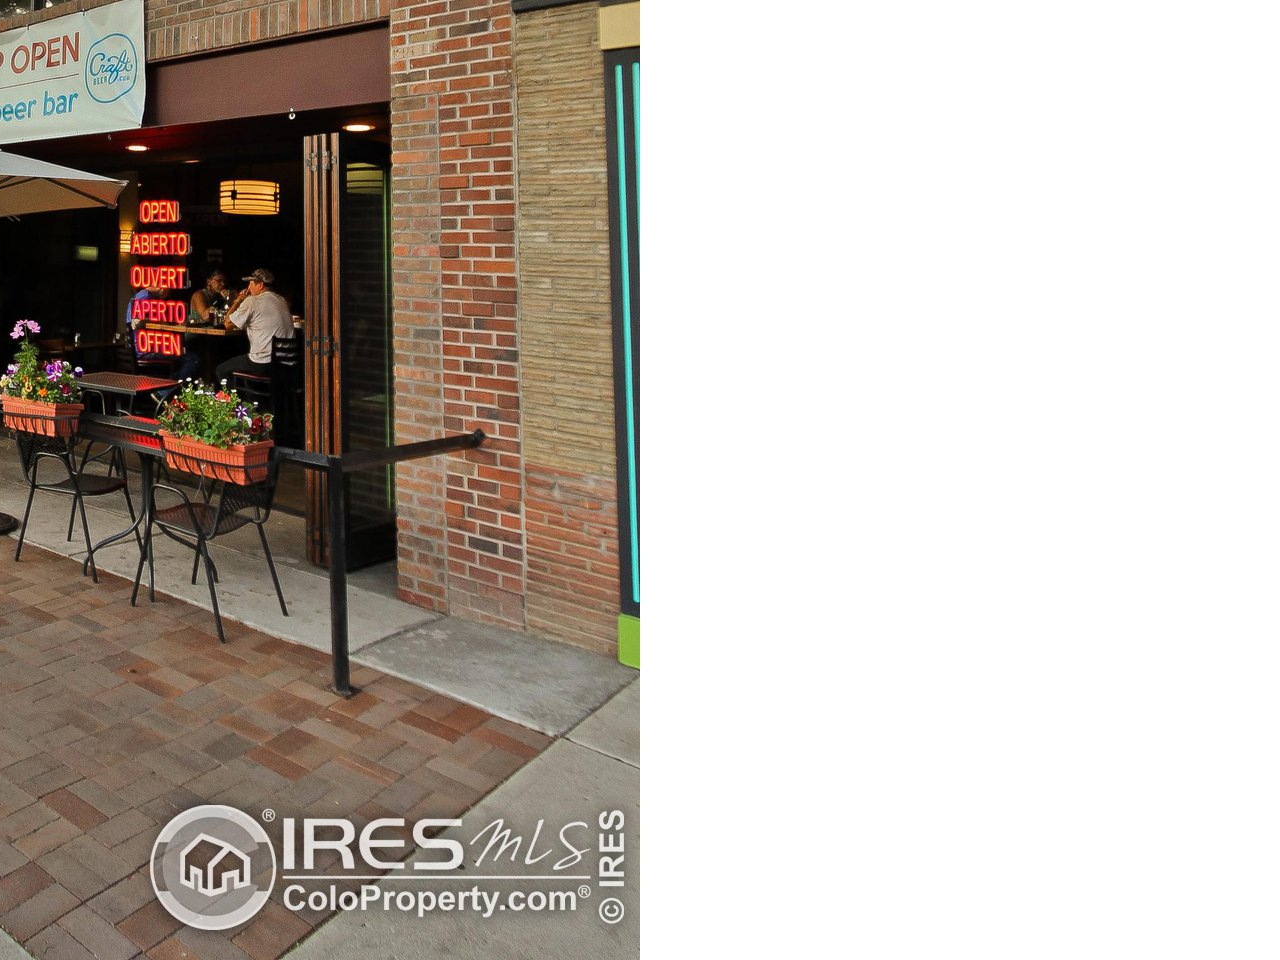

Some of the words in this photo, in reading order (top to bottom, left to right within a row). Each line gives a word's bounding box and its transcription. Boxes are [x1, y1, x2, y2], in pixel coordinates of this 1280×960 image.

[11, 32, 80, 75] OPEN
[89, 49, 133, 84] Craft
[93, 76, 108, 86] BEER
[43, 91, 78, 116] bar
[140, 200, 179, 223] OPEN
[131, 232, 189, 256] ABIERTO
[131, 265, 186, 289] OUVERT
[132, 299, 187, 324] APERTO
[137, 330, 182, 356] OFFEN
